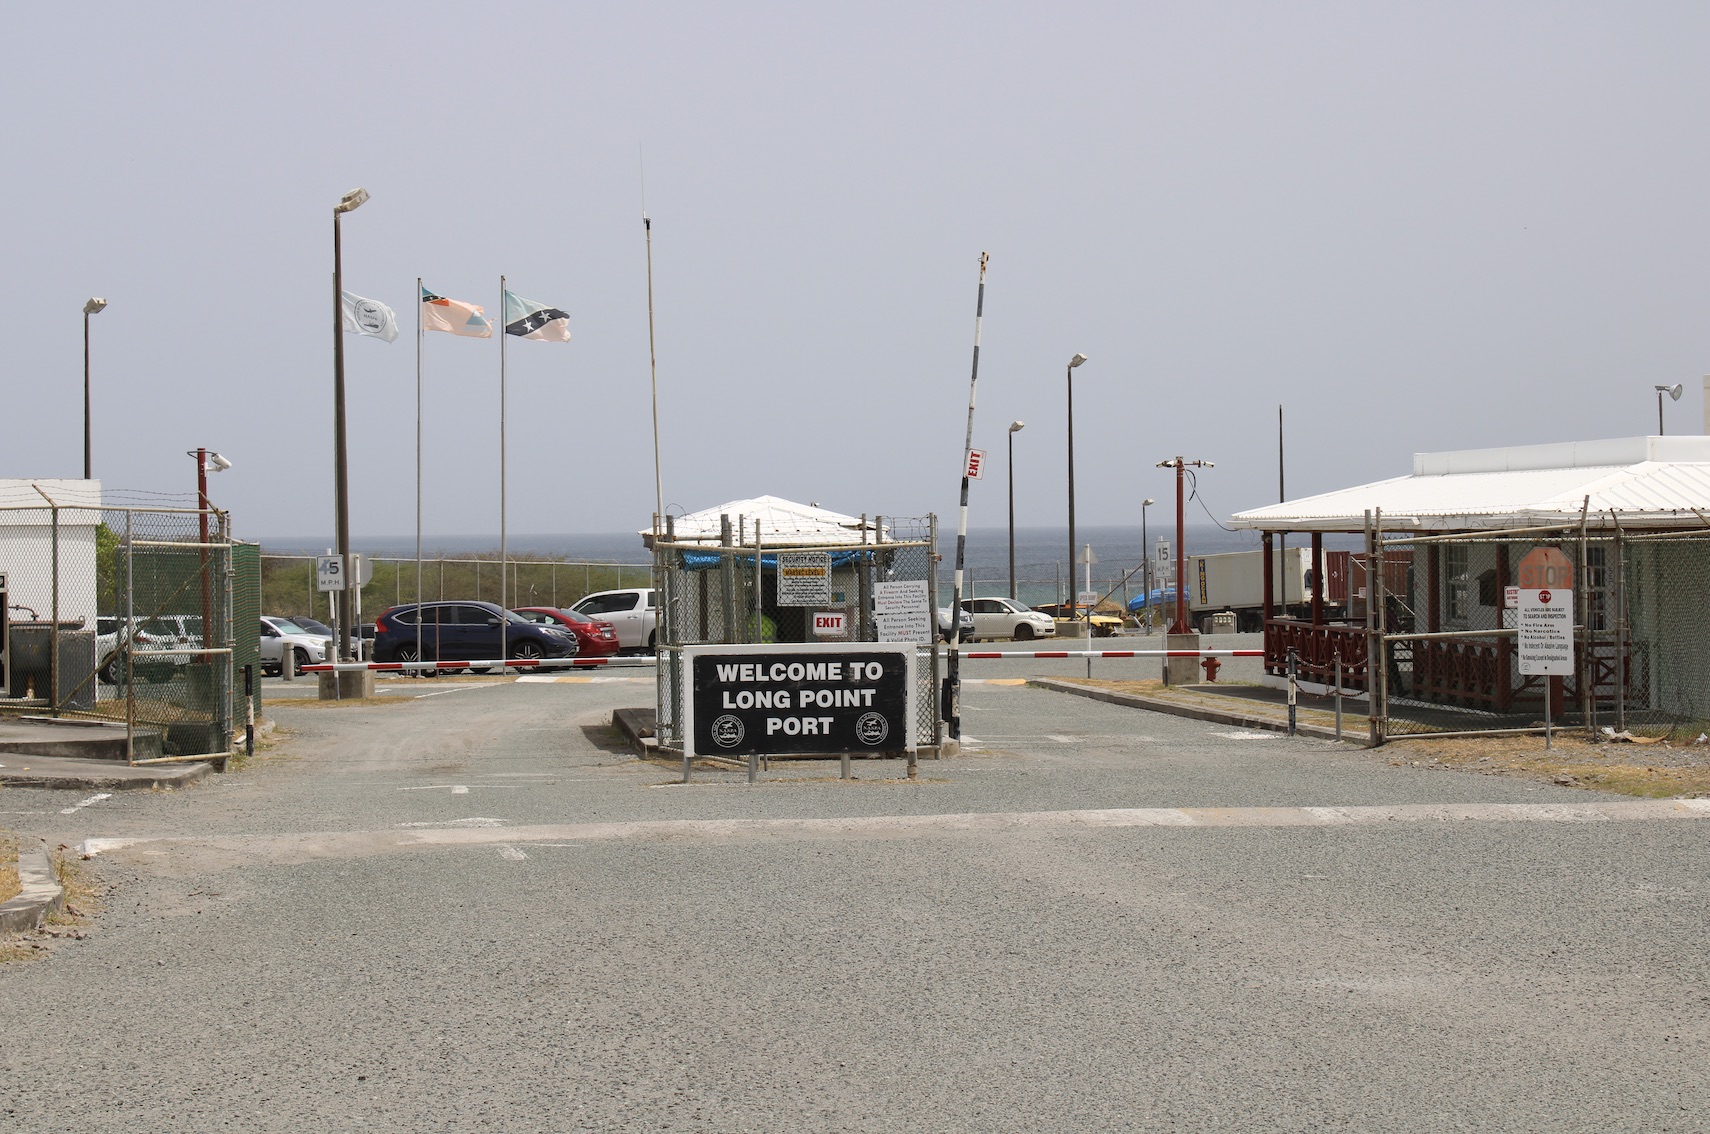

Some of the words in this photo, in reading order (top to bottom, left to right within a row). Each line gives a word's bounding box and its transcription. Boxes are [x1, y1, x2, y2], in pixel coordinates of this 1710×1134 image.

[968, 451, 981, 477] EXIT
[1158, 547, 1168, 560] 15
[1523, 564, 1570, 586] STOP
[816, 618, 842, 628] EXIT
[716, 662, 842, 682] WELCOME
[850, 662, 884, 680] TO
[722, 690, 791, 710] LONG
[800, 688, 876, 708] POINT
[766, 716, 834, 736] PORT
